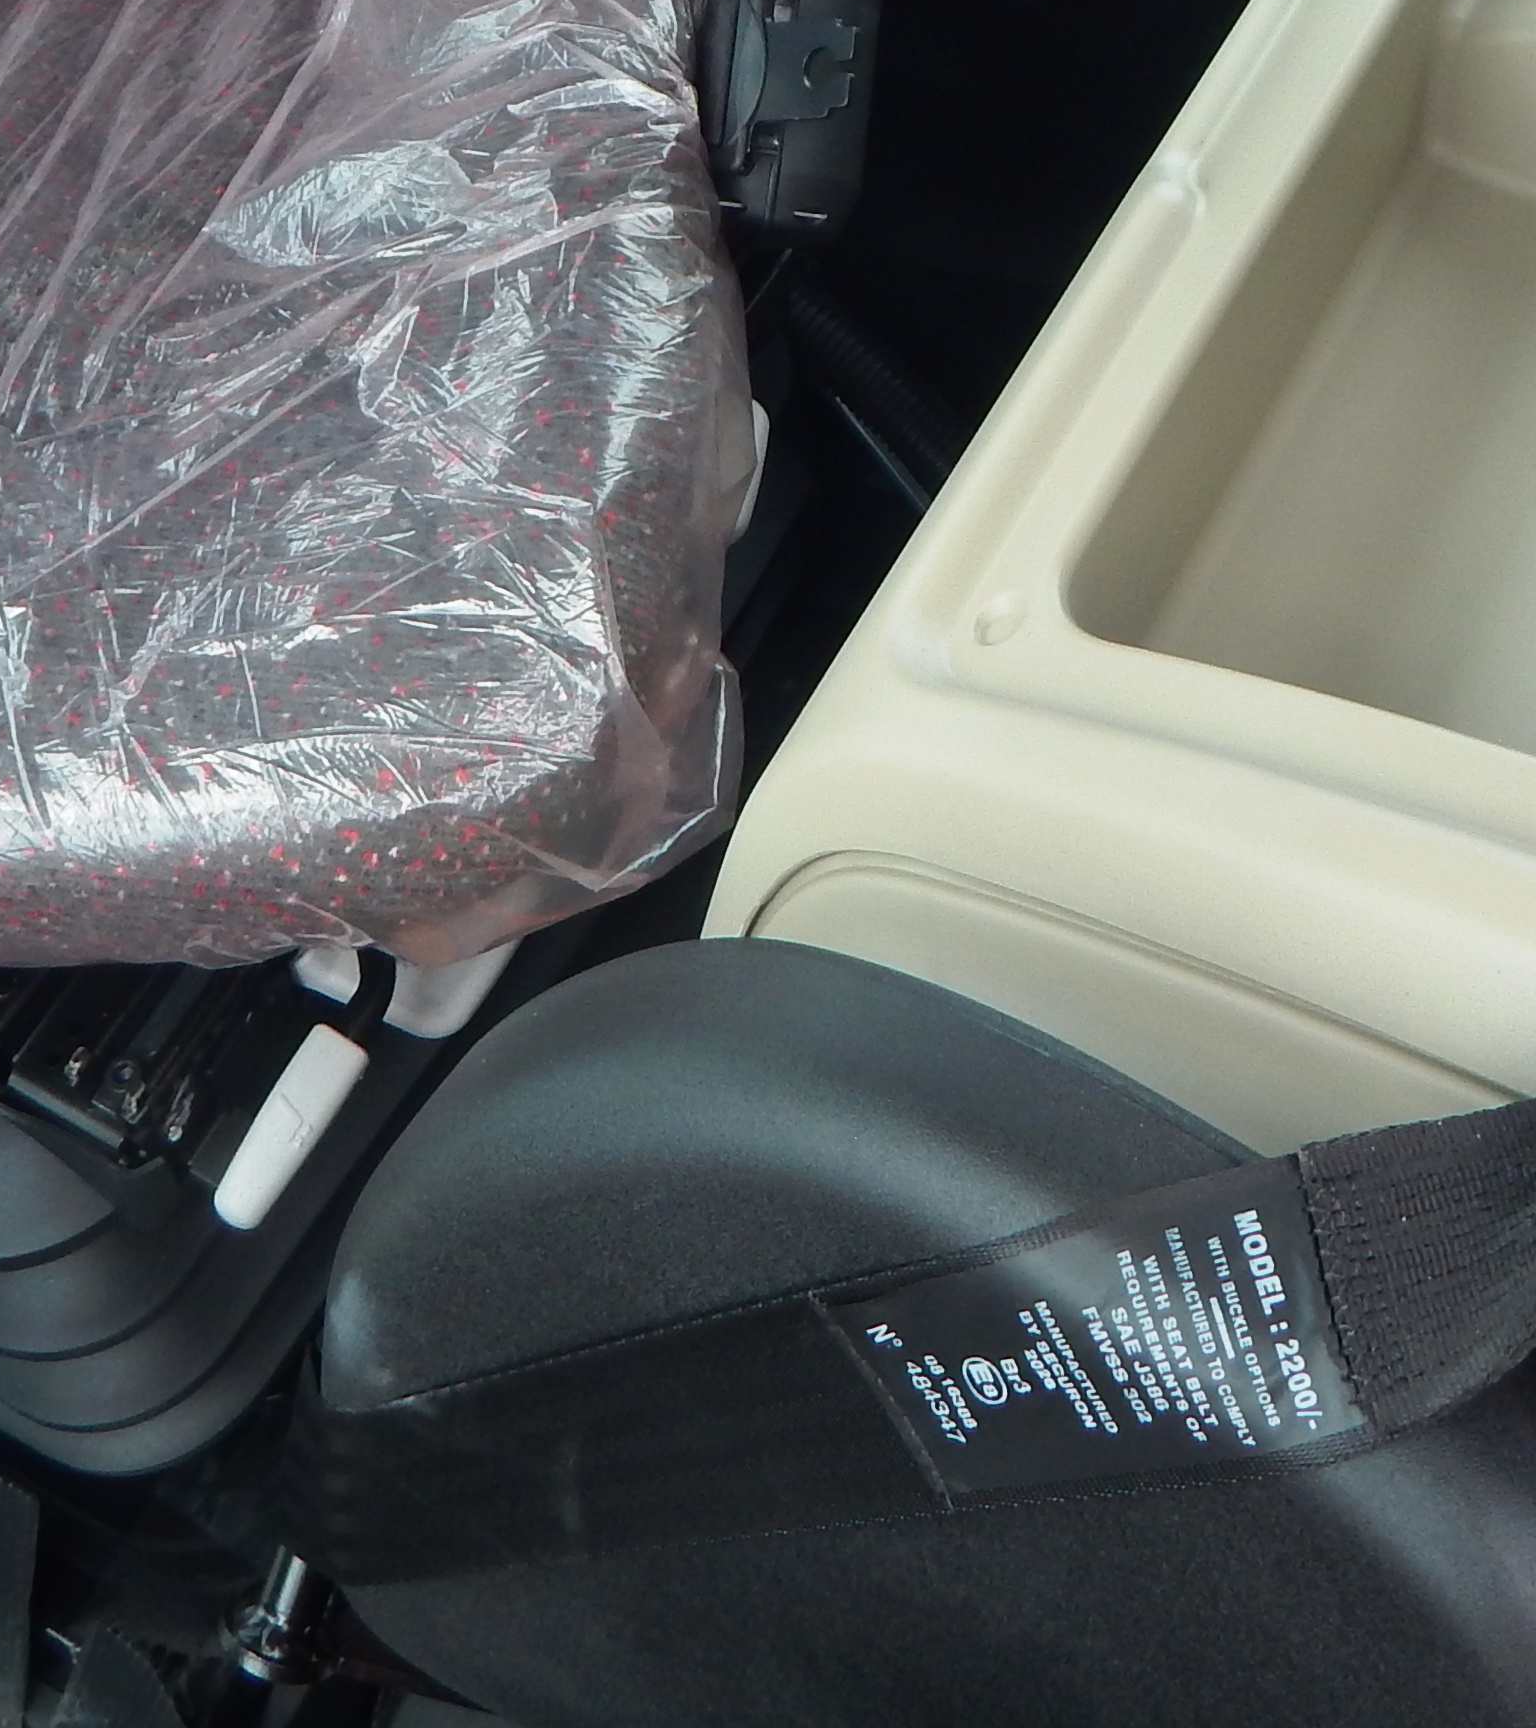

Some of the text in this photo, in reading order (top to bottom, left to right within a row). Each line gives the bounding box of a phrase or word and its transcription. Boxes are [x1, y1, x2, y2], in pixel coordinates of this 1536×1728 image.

[1233, 1209, 1286, 1316] MODEL
[999, 1358, 1032, 1394] Br3
[1018, 1300, 1119, 1434] MANUFACTURED BY SECURON
[1081, 1305, 1153, 1424] FMVSS 302
[1111, 1306, 1170, 1412] SAE J386
[1116, 1249, 1208, 1442] REQUIREMENTS OF
[1142, 1254, 1219, 1426] WITH SEAT BELT
[1165, 1227, 1257, 1446] MANUFACTURED TO COMPLY
[1207, 1236, 1281, 1427] WITH BUCKLE OPTIONS
[906, 1361, 967, 1444] 484347
